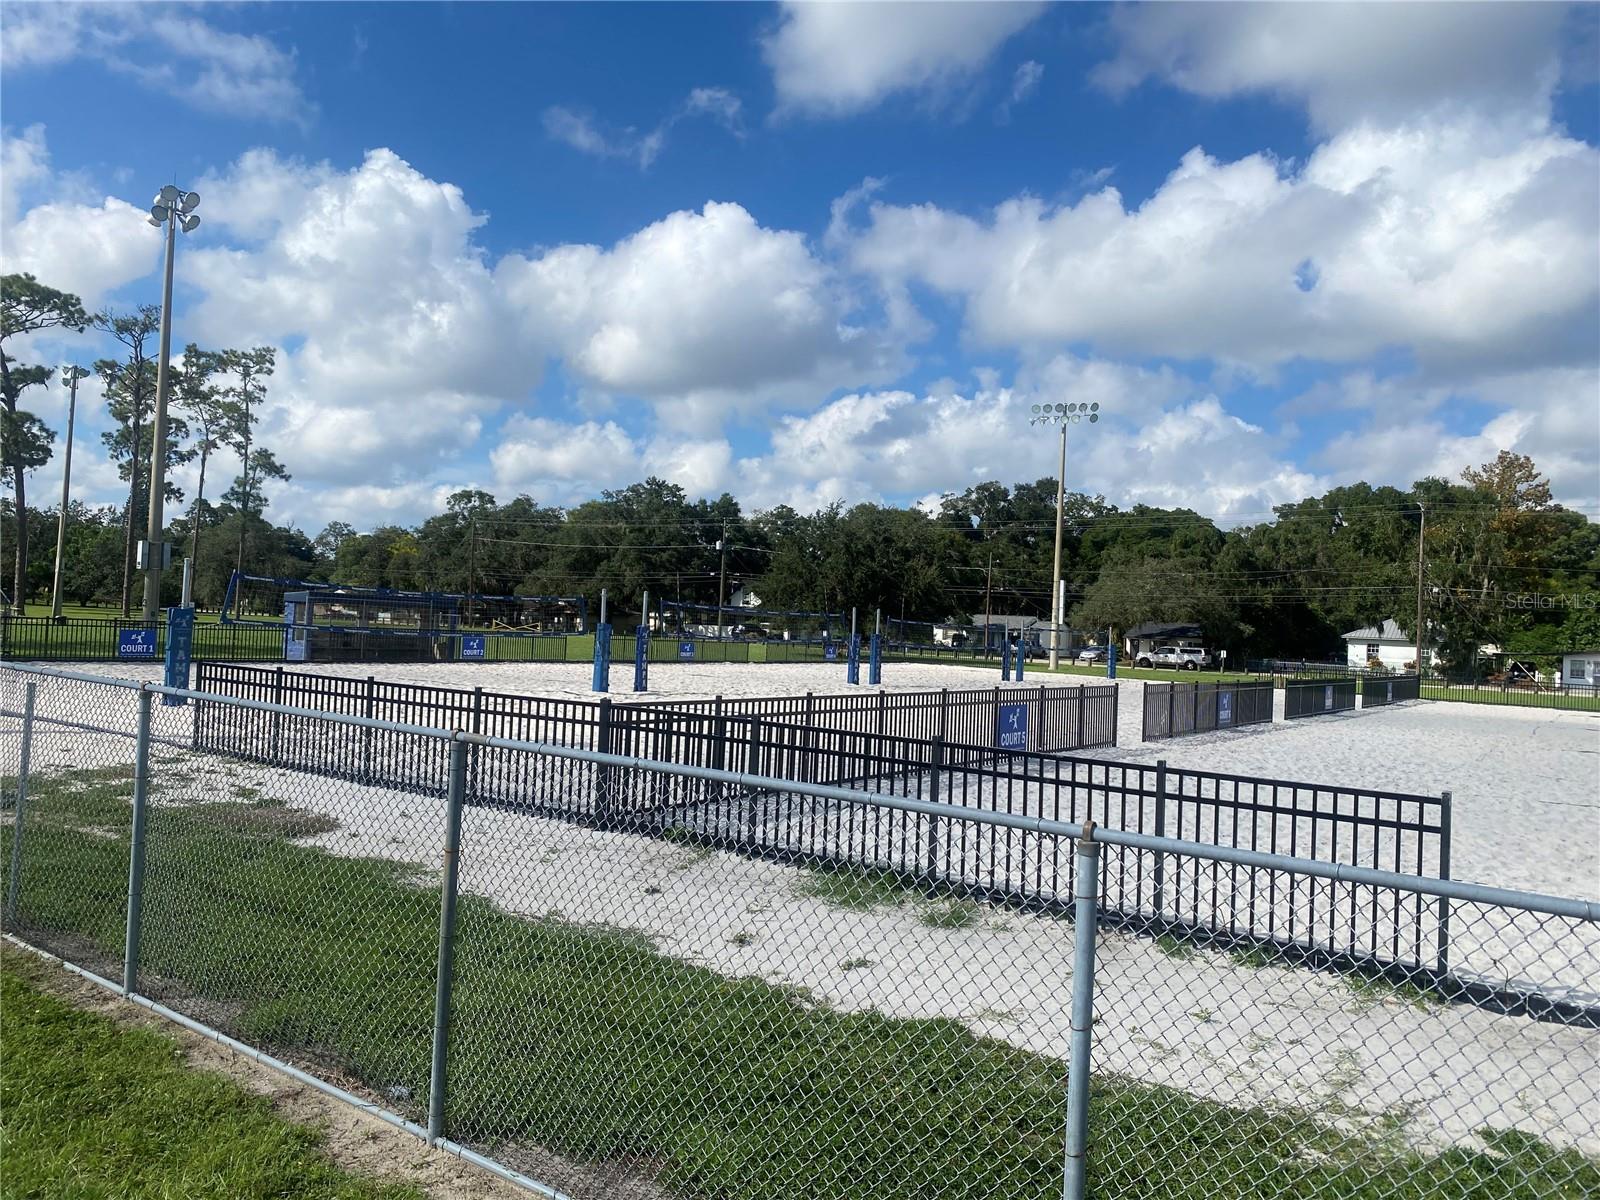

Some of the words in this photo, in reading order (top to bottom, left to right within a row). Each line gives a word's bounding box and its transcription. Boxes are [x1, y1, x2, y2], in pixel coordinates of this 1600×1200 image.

[120, 644, 147, 653] COURT
[149, 644, 154, 653] 1
[175, 636, 188, 689] TAMP
[1001, 731, 1021, 746] COURT
[1021, 731, 1026, 744] 5
